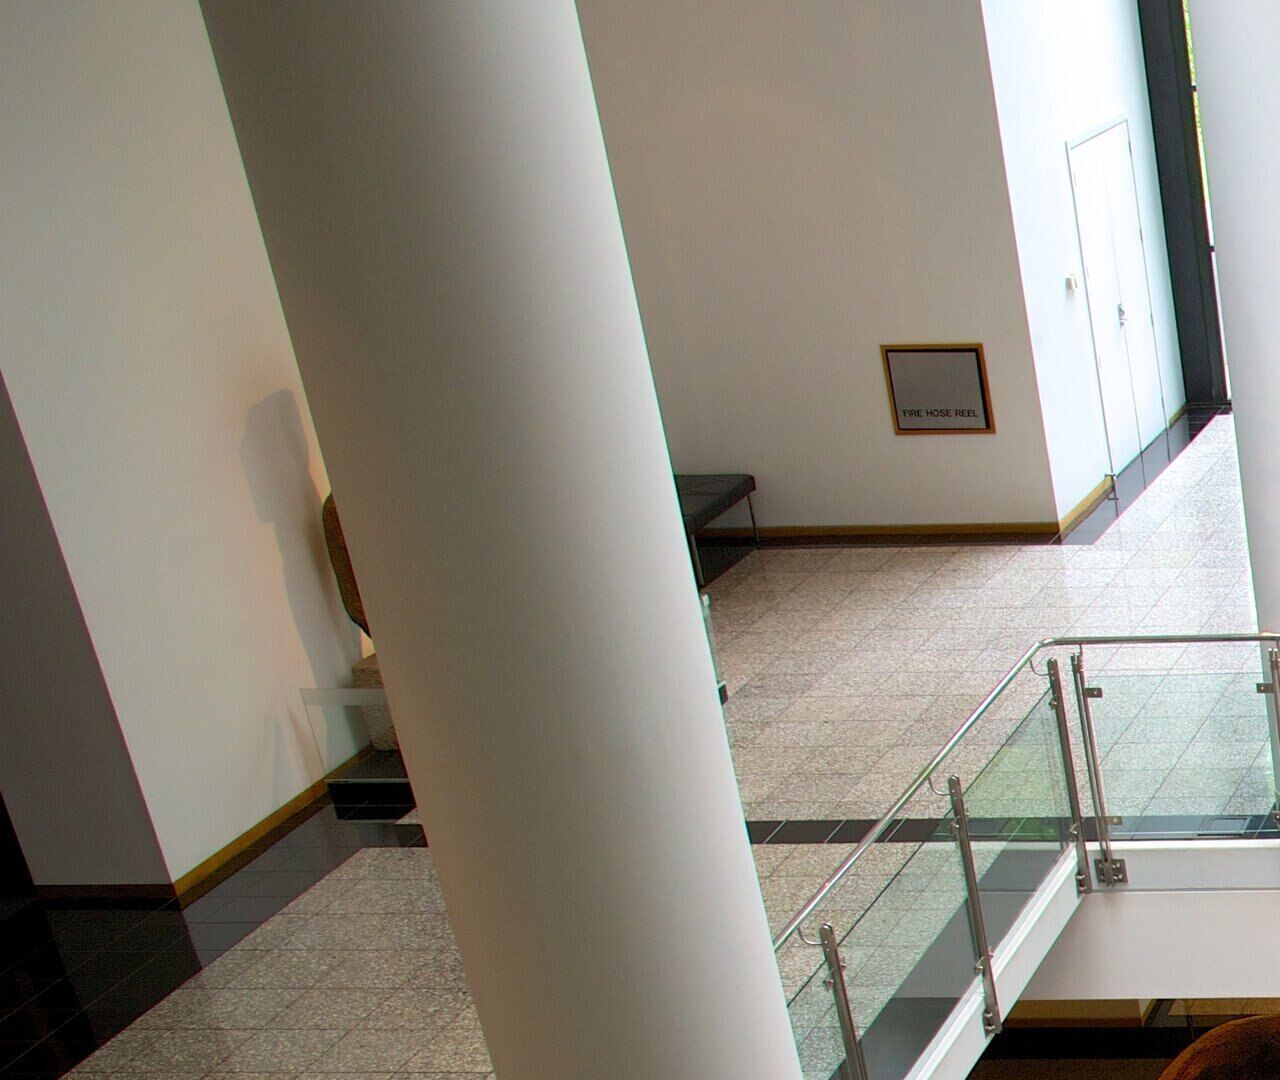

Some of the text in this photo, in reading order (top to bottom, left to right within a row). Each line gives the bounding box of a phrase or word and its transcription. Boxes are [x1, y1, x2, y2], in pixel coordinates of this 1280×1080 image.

[902, 409, 978, 418] FIRE HOSE REEL
